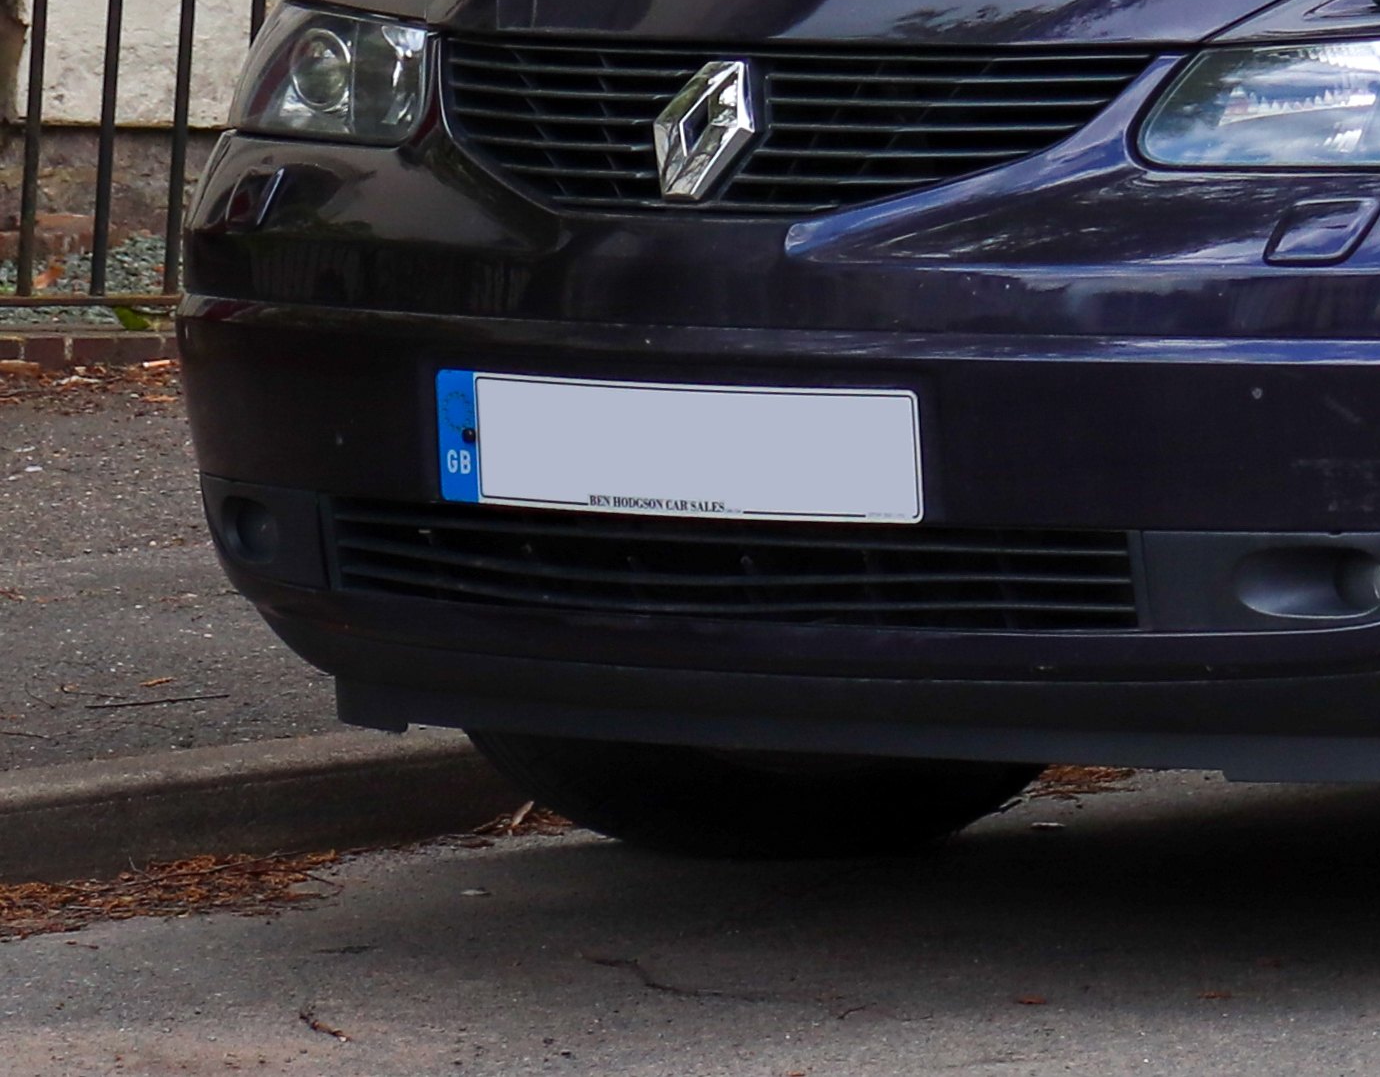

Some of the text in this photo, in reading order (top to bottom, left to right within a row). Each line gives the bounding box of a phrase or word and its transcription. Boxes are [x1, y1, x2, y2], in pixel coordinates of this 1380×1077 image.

[447, 449, 471, 474] GB
[589, 494, 611, 507] BEN
[613, 496, 663, 510] HODGSON
[665, 499, 689, 511] CAR
[691, 501, 725, 513] SALES
